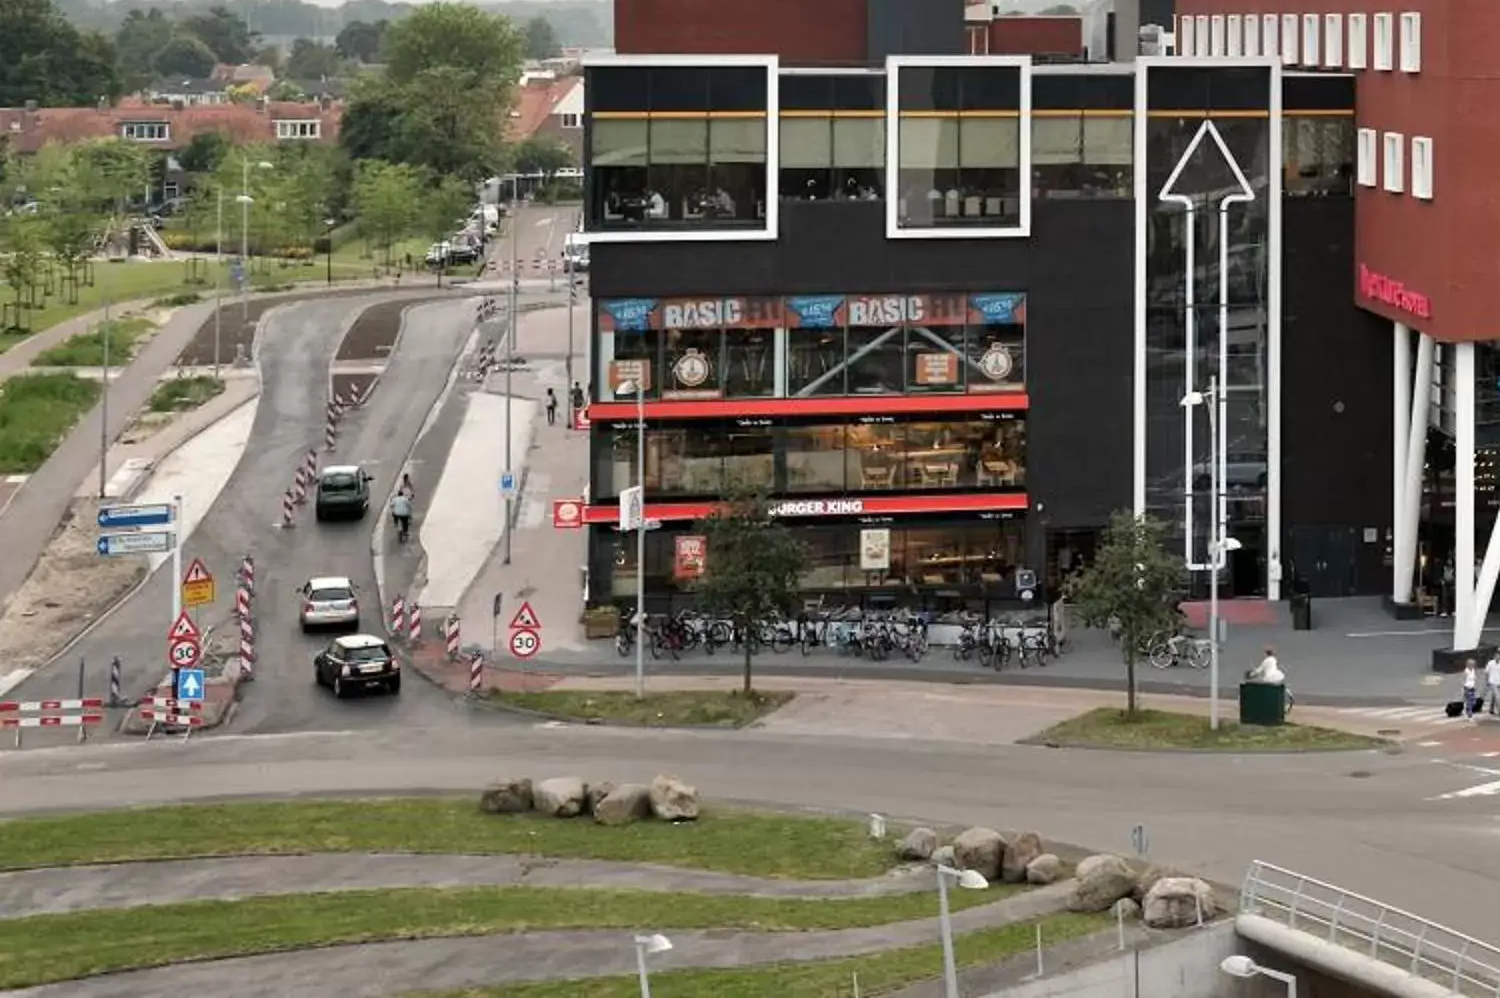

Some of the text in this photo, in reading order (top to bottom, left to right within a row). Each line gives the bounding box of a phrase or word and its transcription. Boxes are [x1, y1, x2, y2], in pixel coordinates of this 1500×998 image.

[665, 299, 741, 329] BASIC
[850, 296, 924, 326] BASIC
[827, 499, 863, 514] KING
[515, 637, 535, 648] 30
[175, 646, 195, 660] 30
